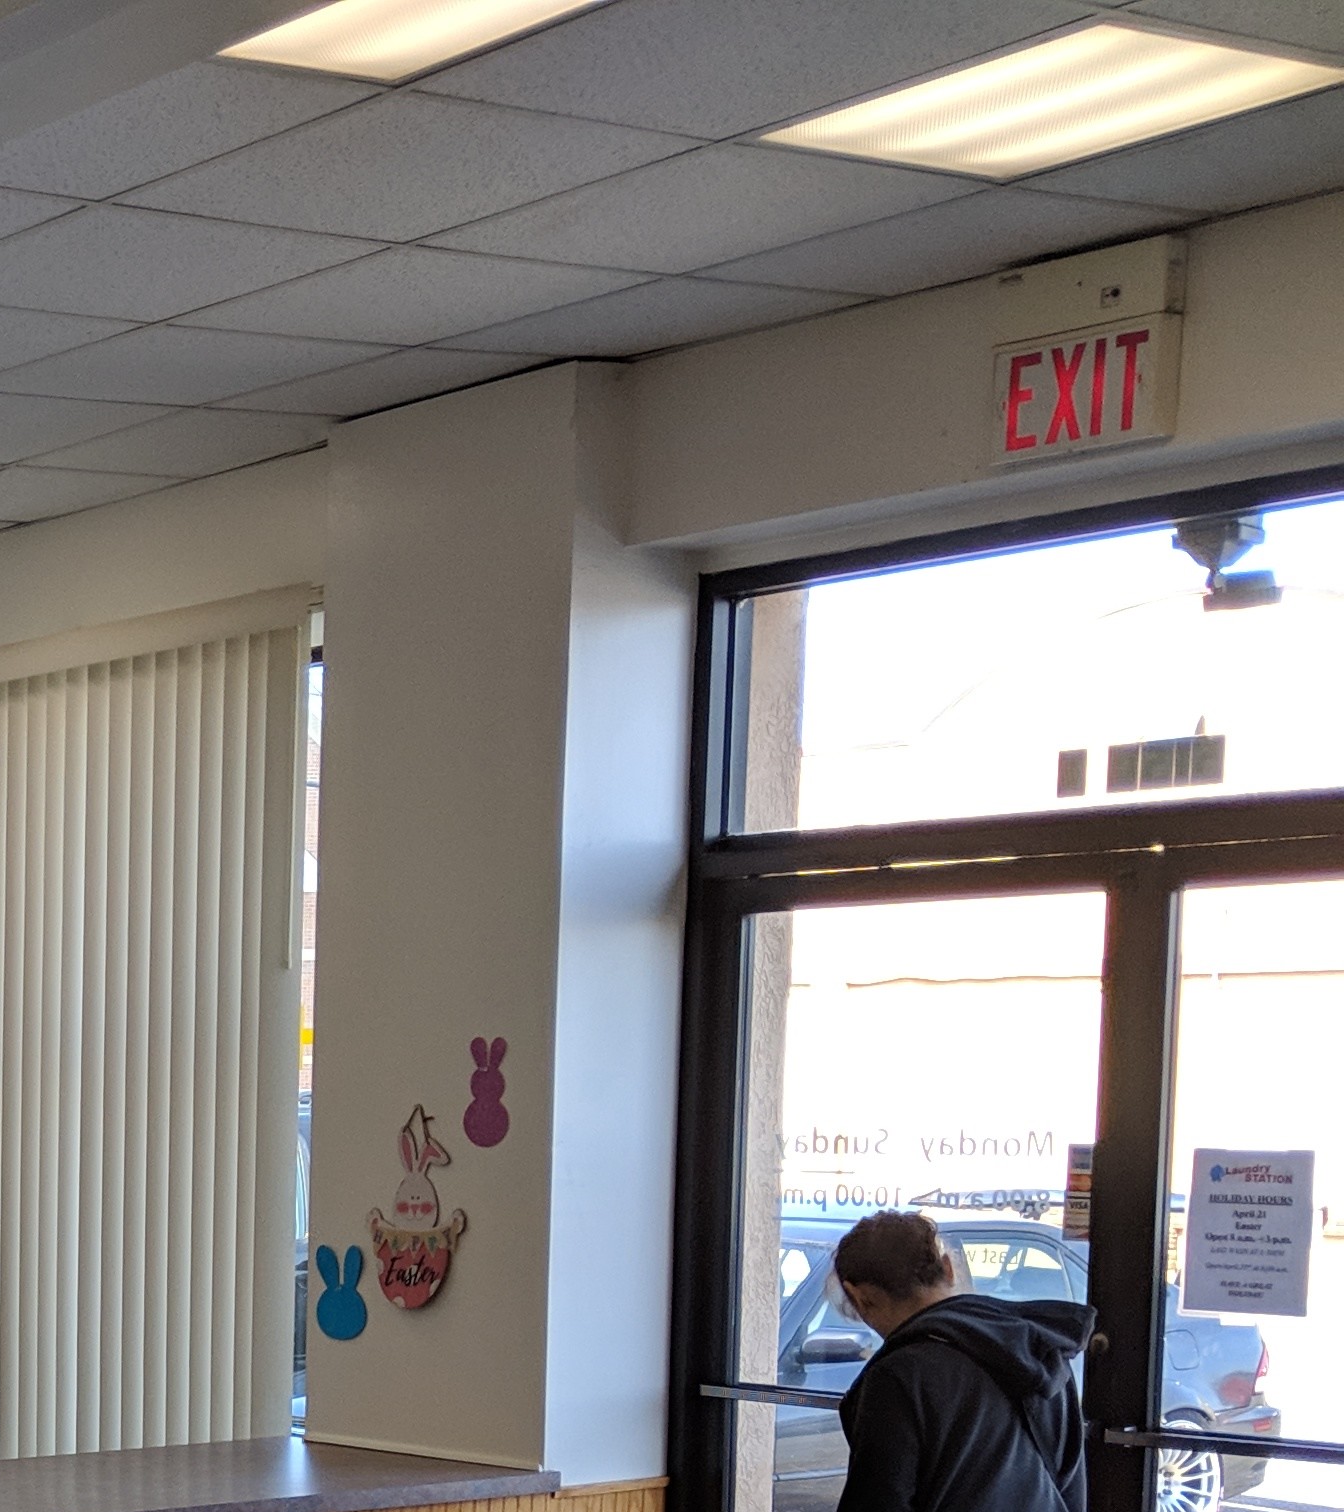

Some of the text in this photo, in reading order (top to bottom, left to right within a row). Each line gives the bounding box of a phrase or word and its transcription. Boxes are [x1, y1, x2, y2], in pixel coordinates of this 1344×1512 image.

[1005, 329, 1149, 452] EXIT
[1225, 1164, 1271, 1175] Laundry
[1245, 1173, 1293, 1184] STATION
[1070, 1201, 1089, 1210] VISA
[1209, 1194, 1293, 1206] HOLIDAY HOURS
[1233, 1210, 1267, 1219] April 21
[385, 1255, 439, 1286] Easter
